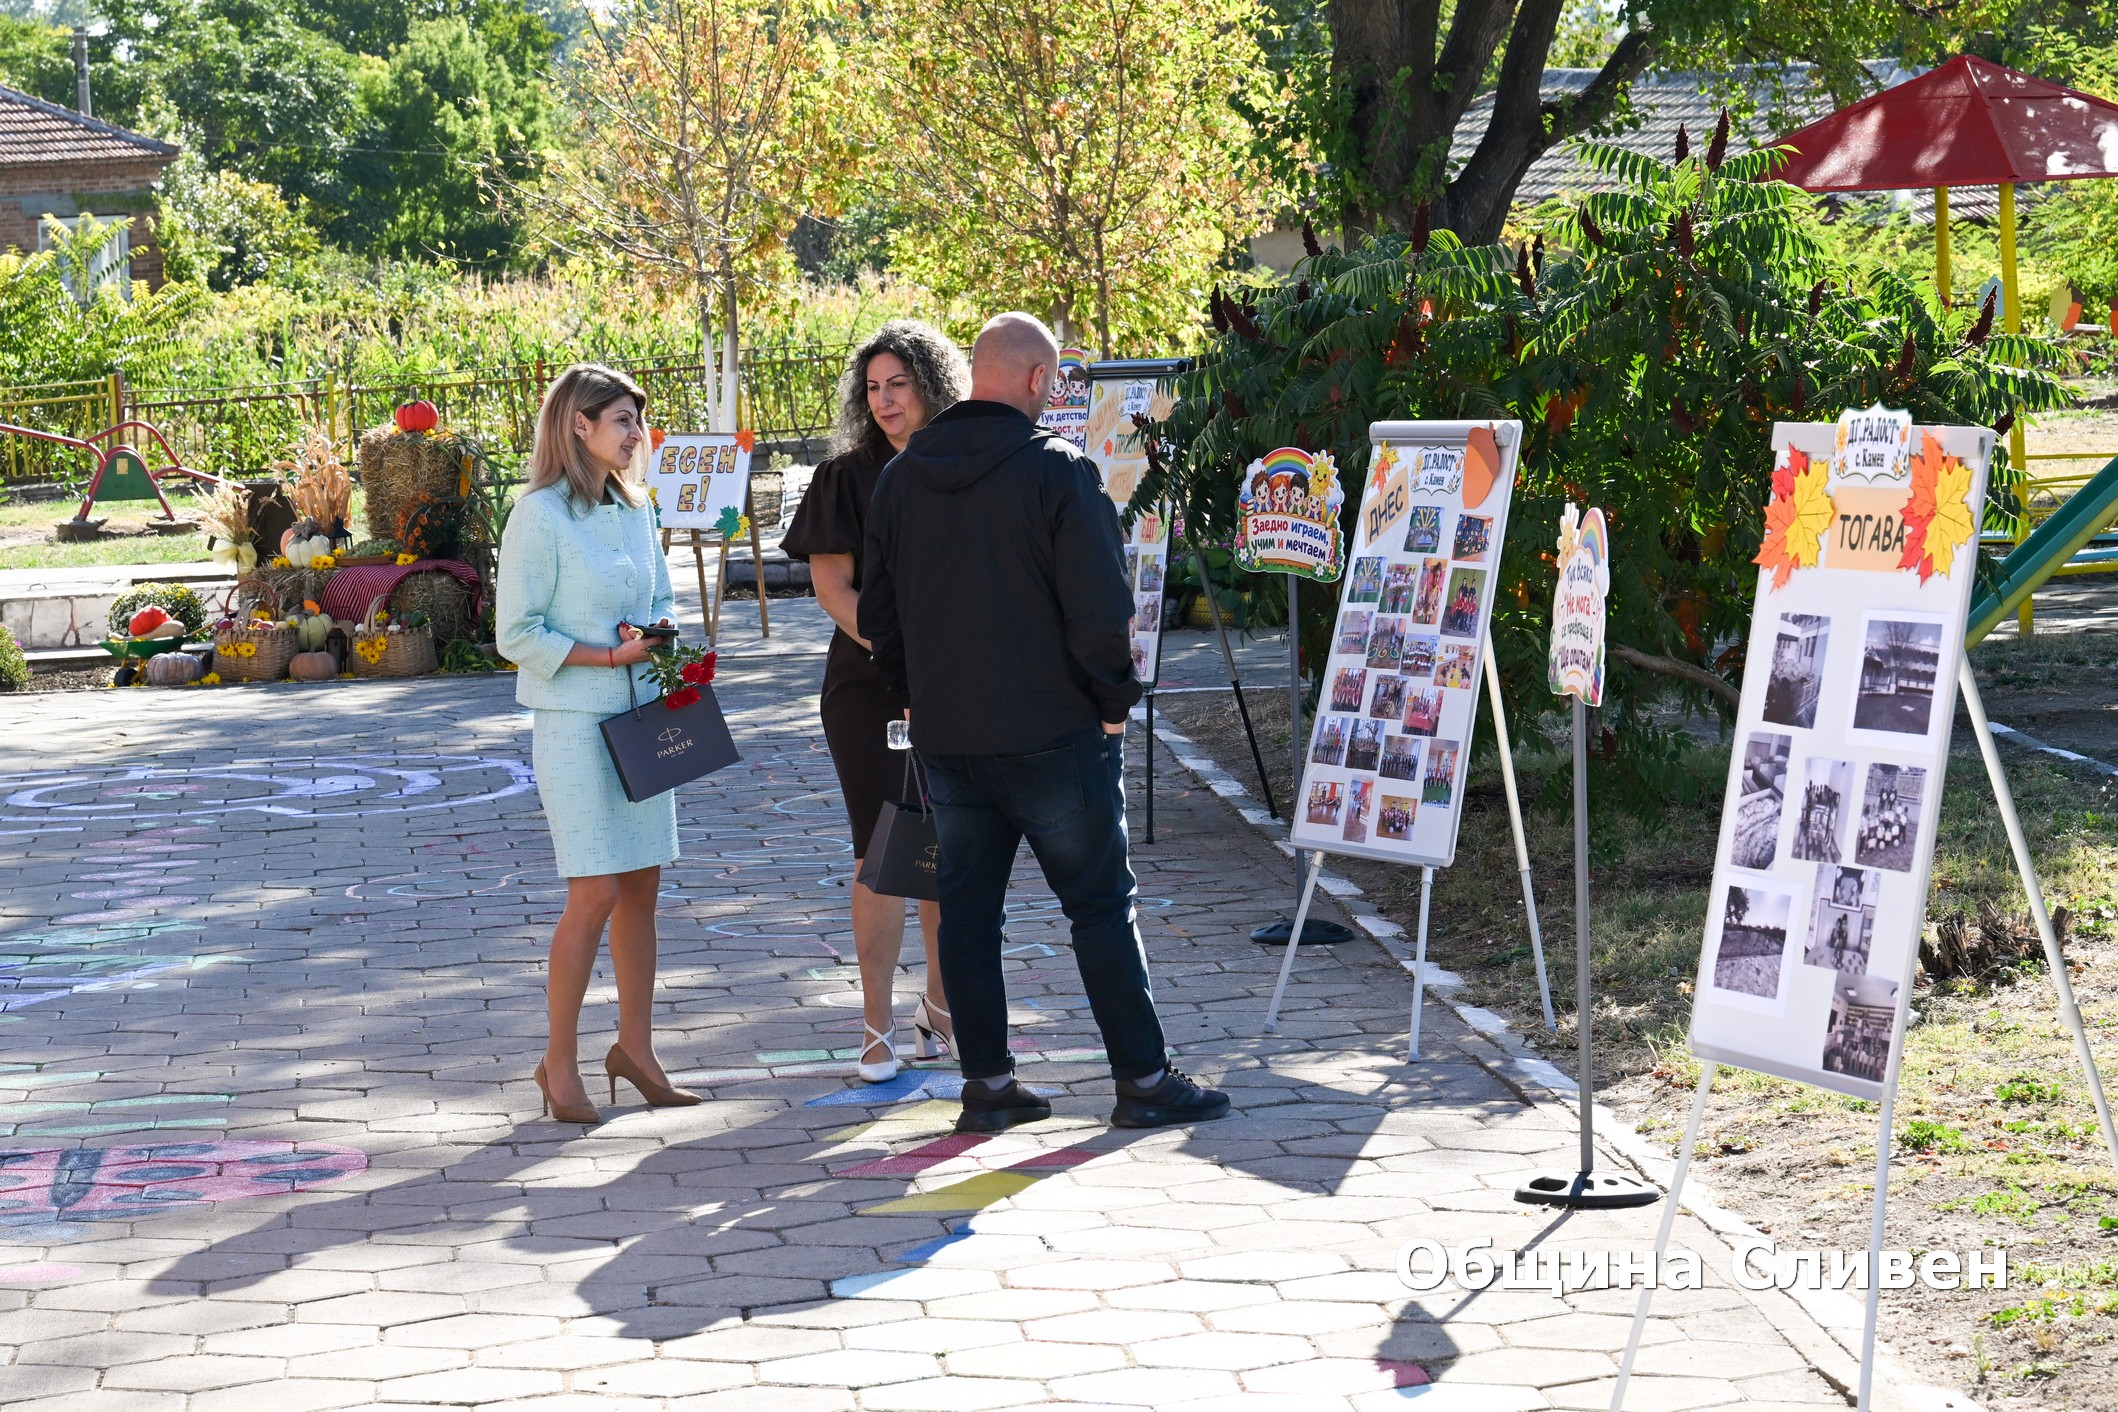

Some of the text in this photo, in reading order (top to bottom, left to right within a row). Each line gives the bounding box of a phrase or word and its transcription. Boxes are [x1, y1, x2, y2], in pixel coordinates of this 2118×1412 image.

[1056, 412, 1087, 422] детство
[659, 445, 738, 474] ЕСЕН
[1862, 448, 1885, 468] Камен
[677, 475, 711, 513] Е!
[1369, 484, 1404, 543] ДНЕС
[1252, 517, 1329, 547] Заедно играем,
[1840, 513, 1904, 553] ТОГАВА
[1251, 537, 1276, 556] учим
[1277, 538, 1284, 549] и
[1566, 564, 1577, 589] Тук
[656, 739, 694, 759] PARKER
[914, 859, 938, 870] PARK
